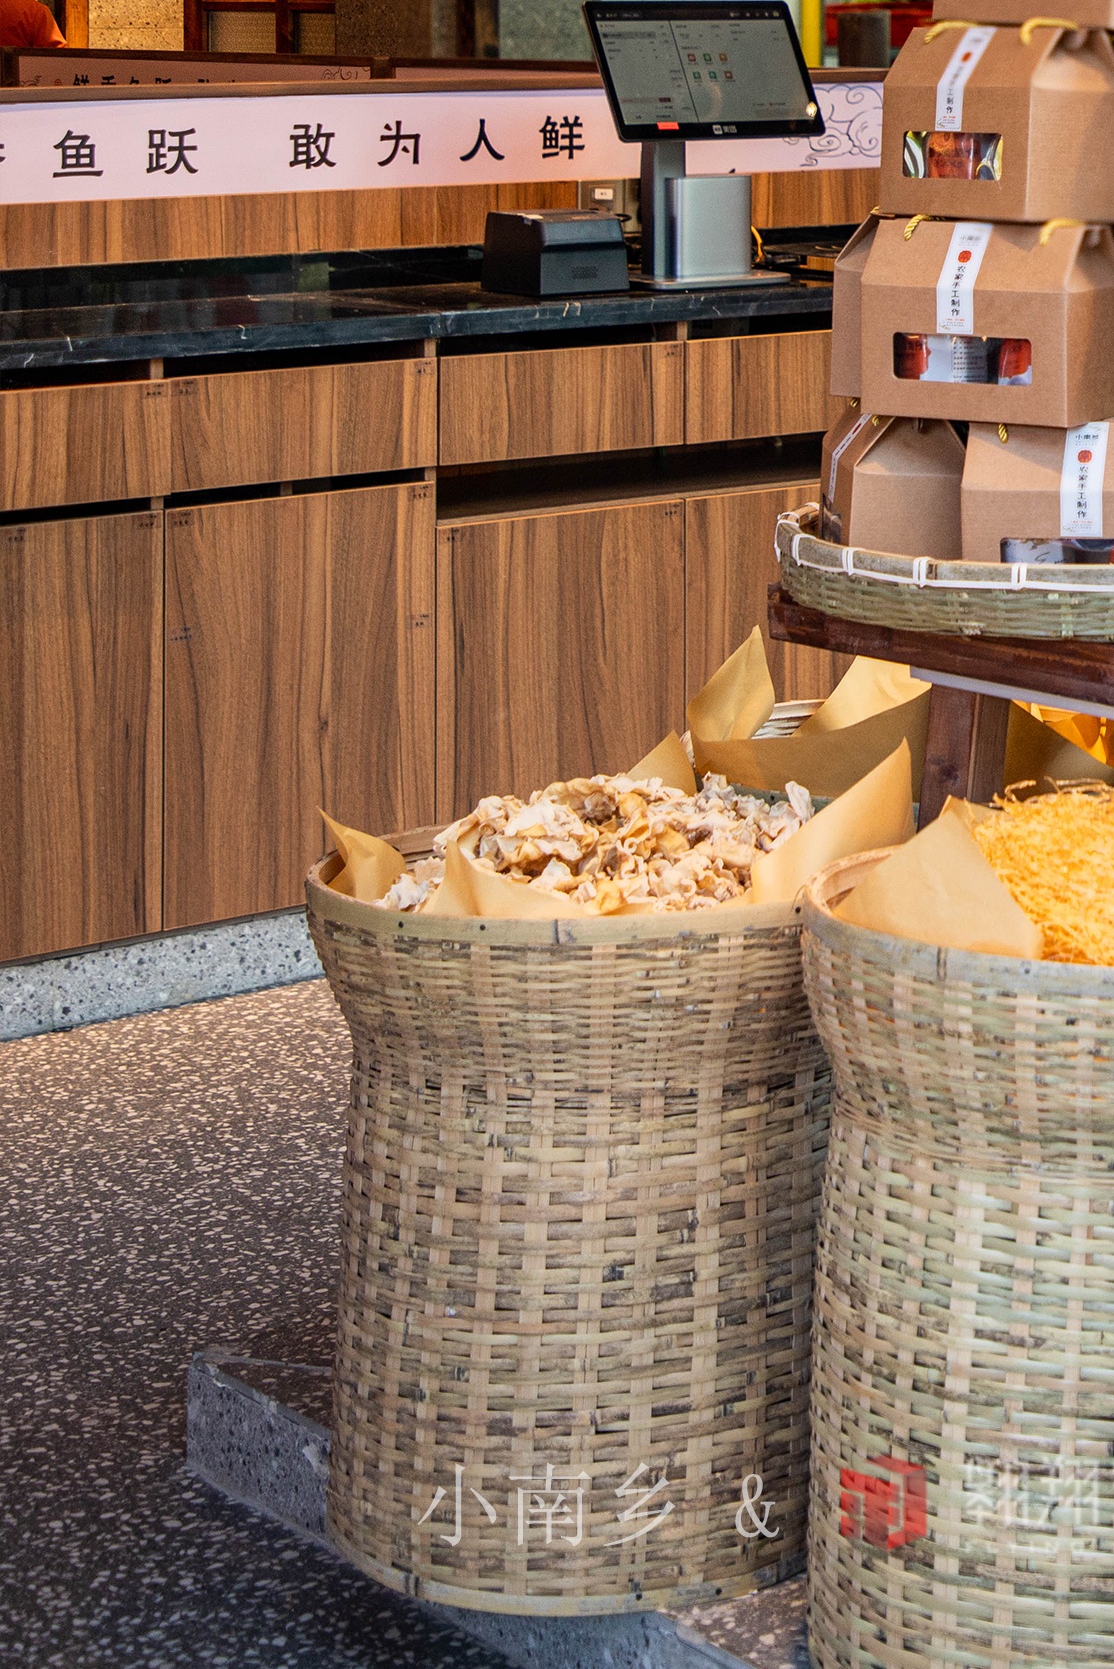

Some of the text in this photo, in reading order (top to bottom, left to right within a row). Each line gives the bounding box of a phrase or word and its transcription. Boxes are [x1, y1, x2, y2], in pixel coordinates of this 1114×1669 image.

[0, 116, 585, 178] 鱼跃 敢为人鲜
[1076, 466, 1089, 519] 农家手工制作
